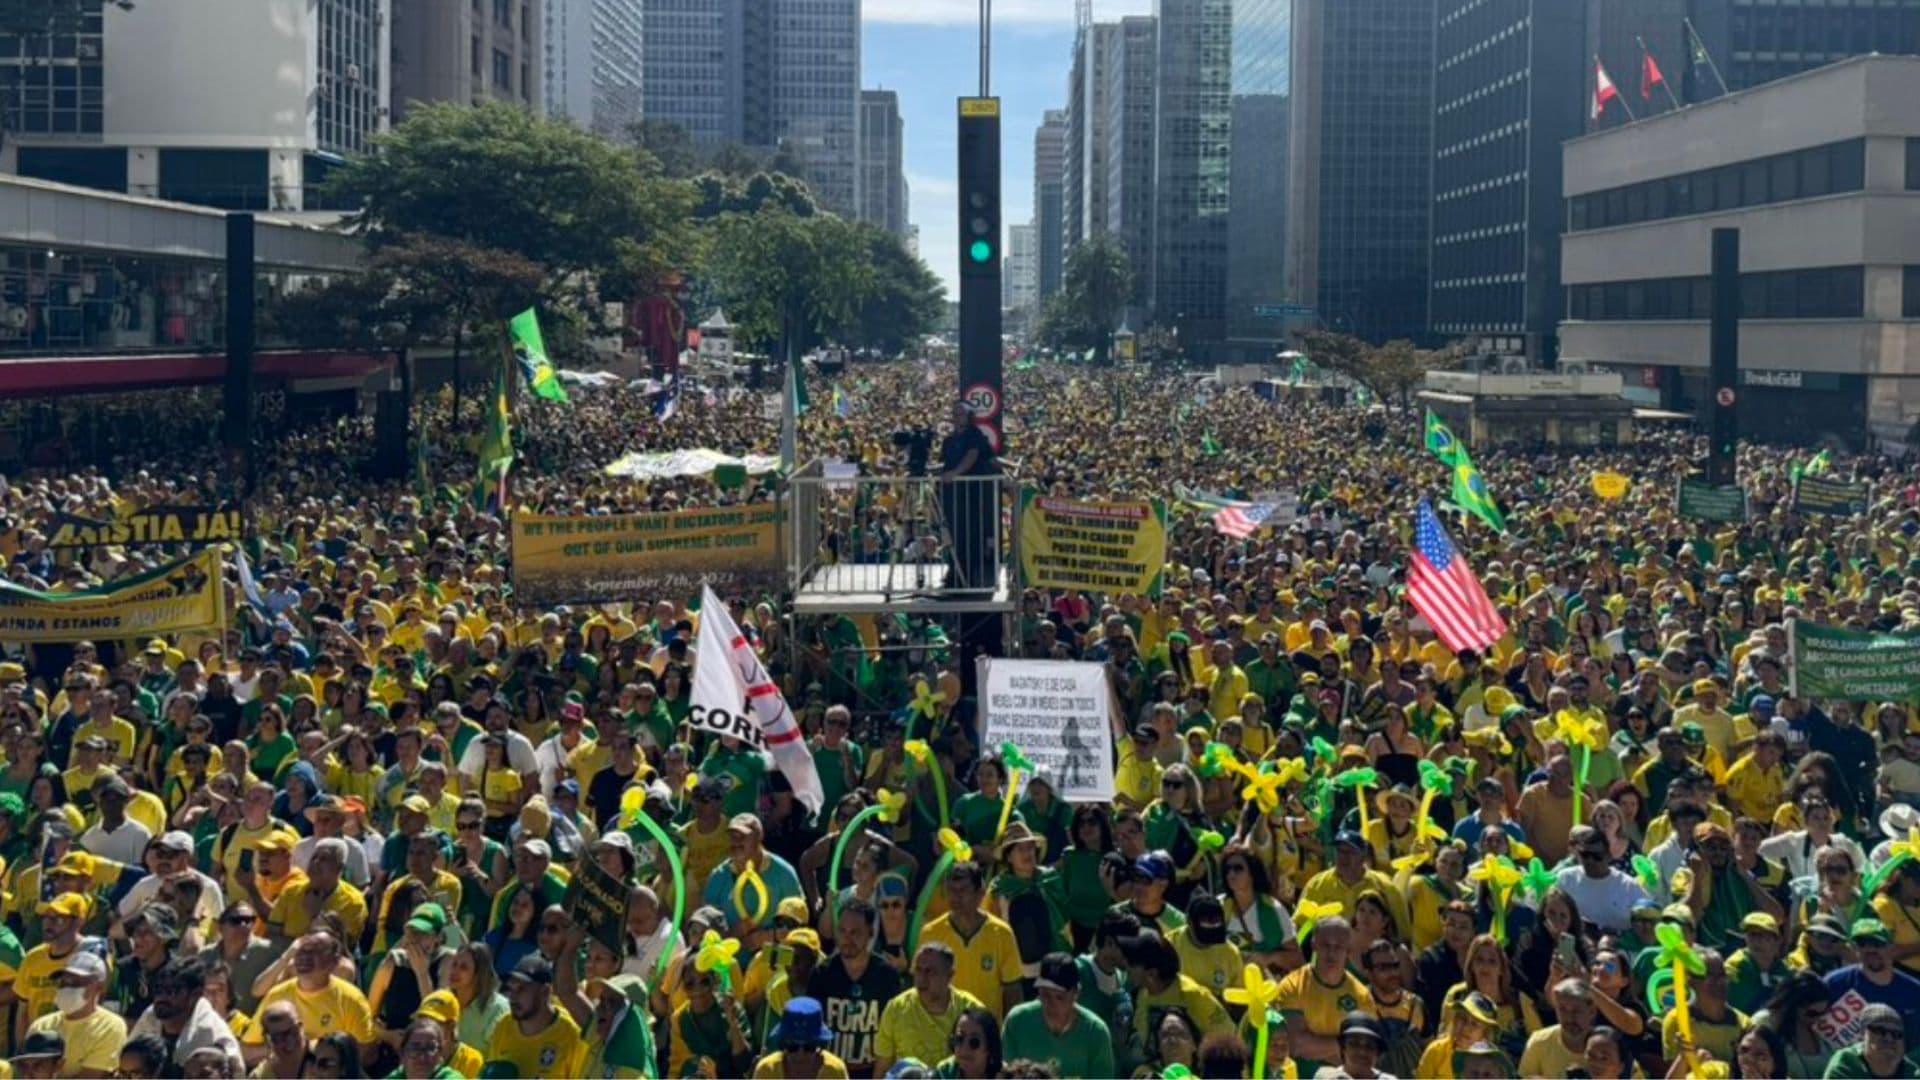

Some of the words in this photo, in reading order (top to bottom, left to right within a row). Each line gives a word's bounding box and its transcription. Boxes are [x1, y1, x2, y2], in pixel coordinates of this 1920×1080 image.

[970, 391, 994, 409] 50
[524, 522, 543, 536] WE
[549, 520, 574, 535] THE
[577, 517, 628, 533] PEOPLE
[633, 515, 669, 531] WANT
[564, 542, 588, 557] OUT
[593, 541, 611, 555] OF
[615, 538, 643, 553] OUR
[584, 576, 659, 593] September
[53, 615, 121, 632] ESTAMOS
[826, 996, 880, 1032] FORA
[1816, 993, 1866, 1038] SOS
[833, 1031, 874, 1064] ULA
